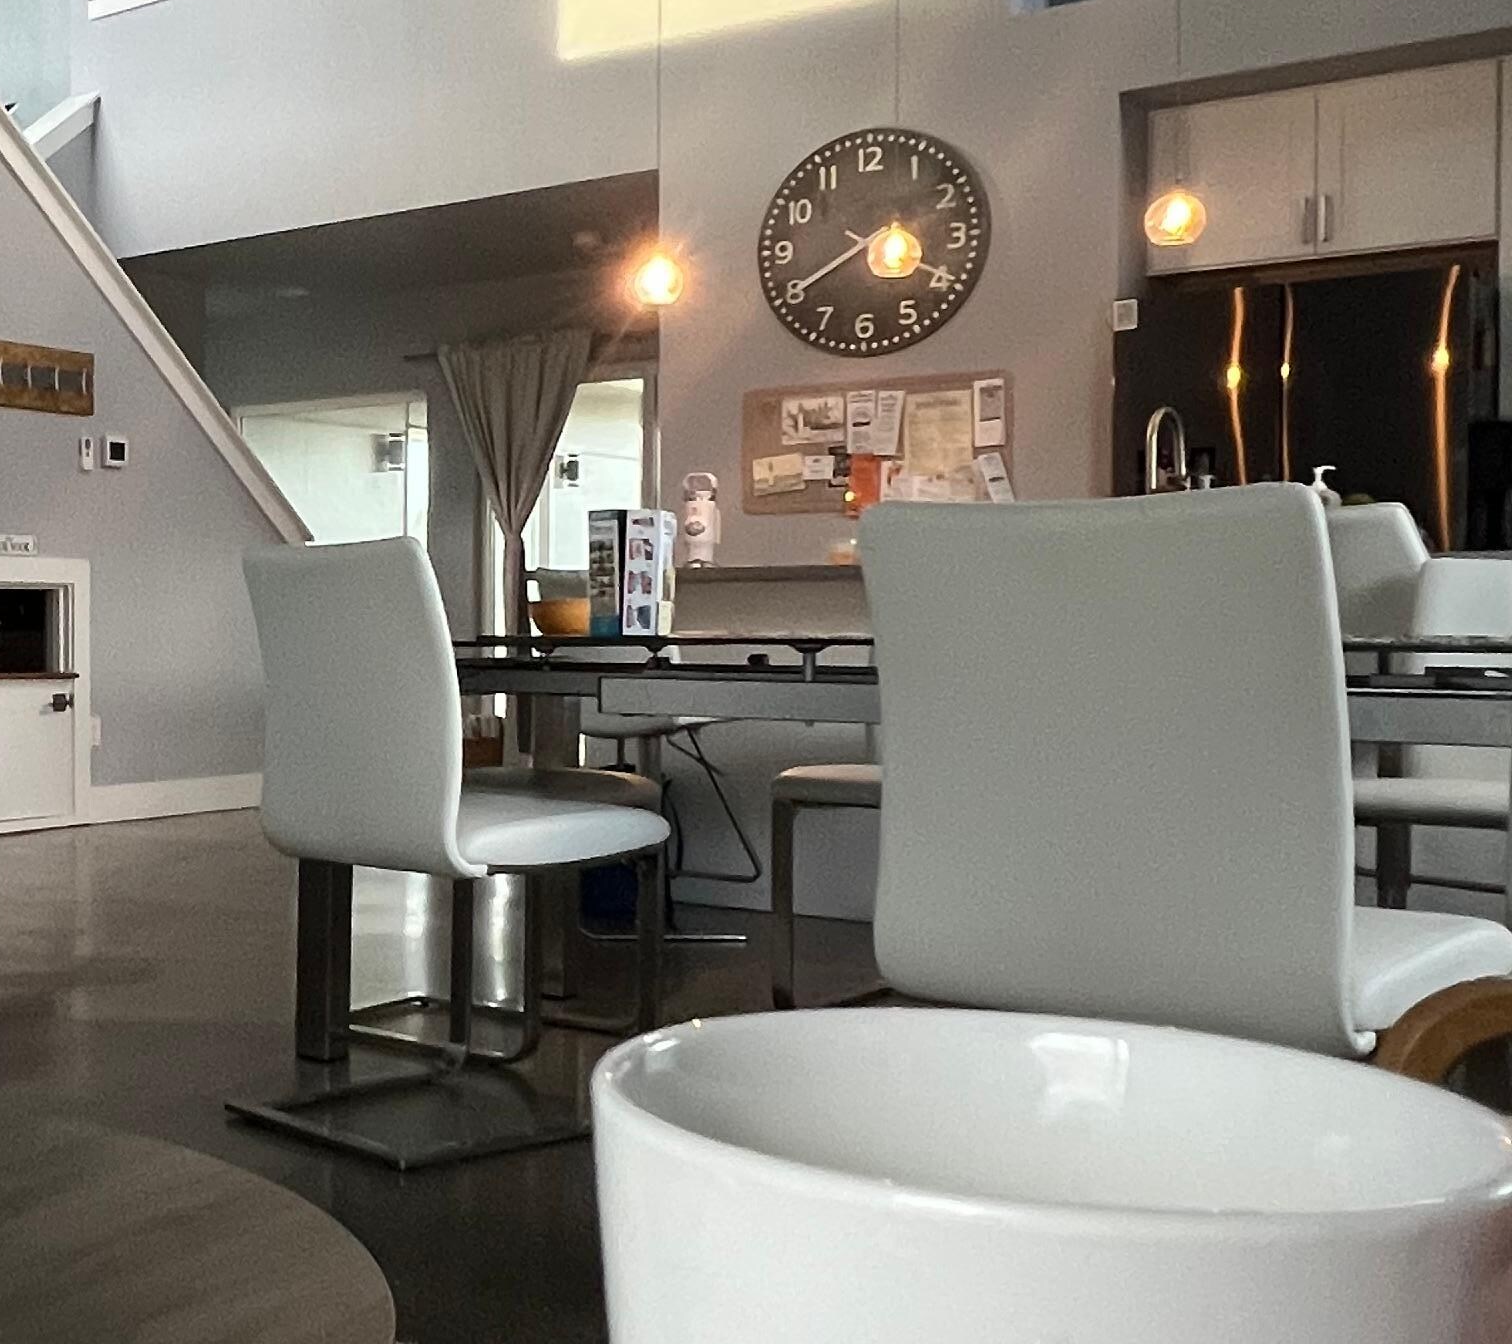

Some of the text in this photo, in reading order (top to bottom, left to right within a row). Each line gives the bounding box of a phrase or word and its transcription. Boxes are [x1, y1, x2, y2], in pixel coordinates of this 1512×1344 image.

[858, 146, 884, 173] 12
[910, 155, 918, 180] 1
[819, 164, 837, 190] 11
[936, 183, 957, 209] 2
[788, 199, 812, 225] 10
[947, 222, 966, 249] 3
[774, 240, 794, 264] 9
[929, 265, 952, 292] 4
[786, 279, 805, 304] 8
[816, 306, 834, 331] 7
[898, 300, 917, 325] 5
[854, 313, 874, 338] 6
